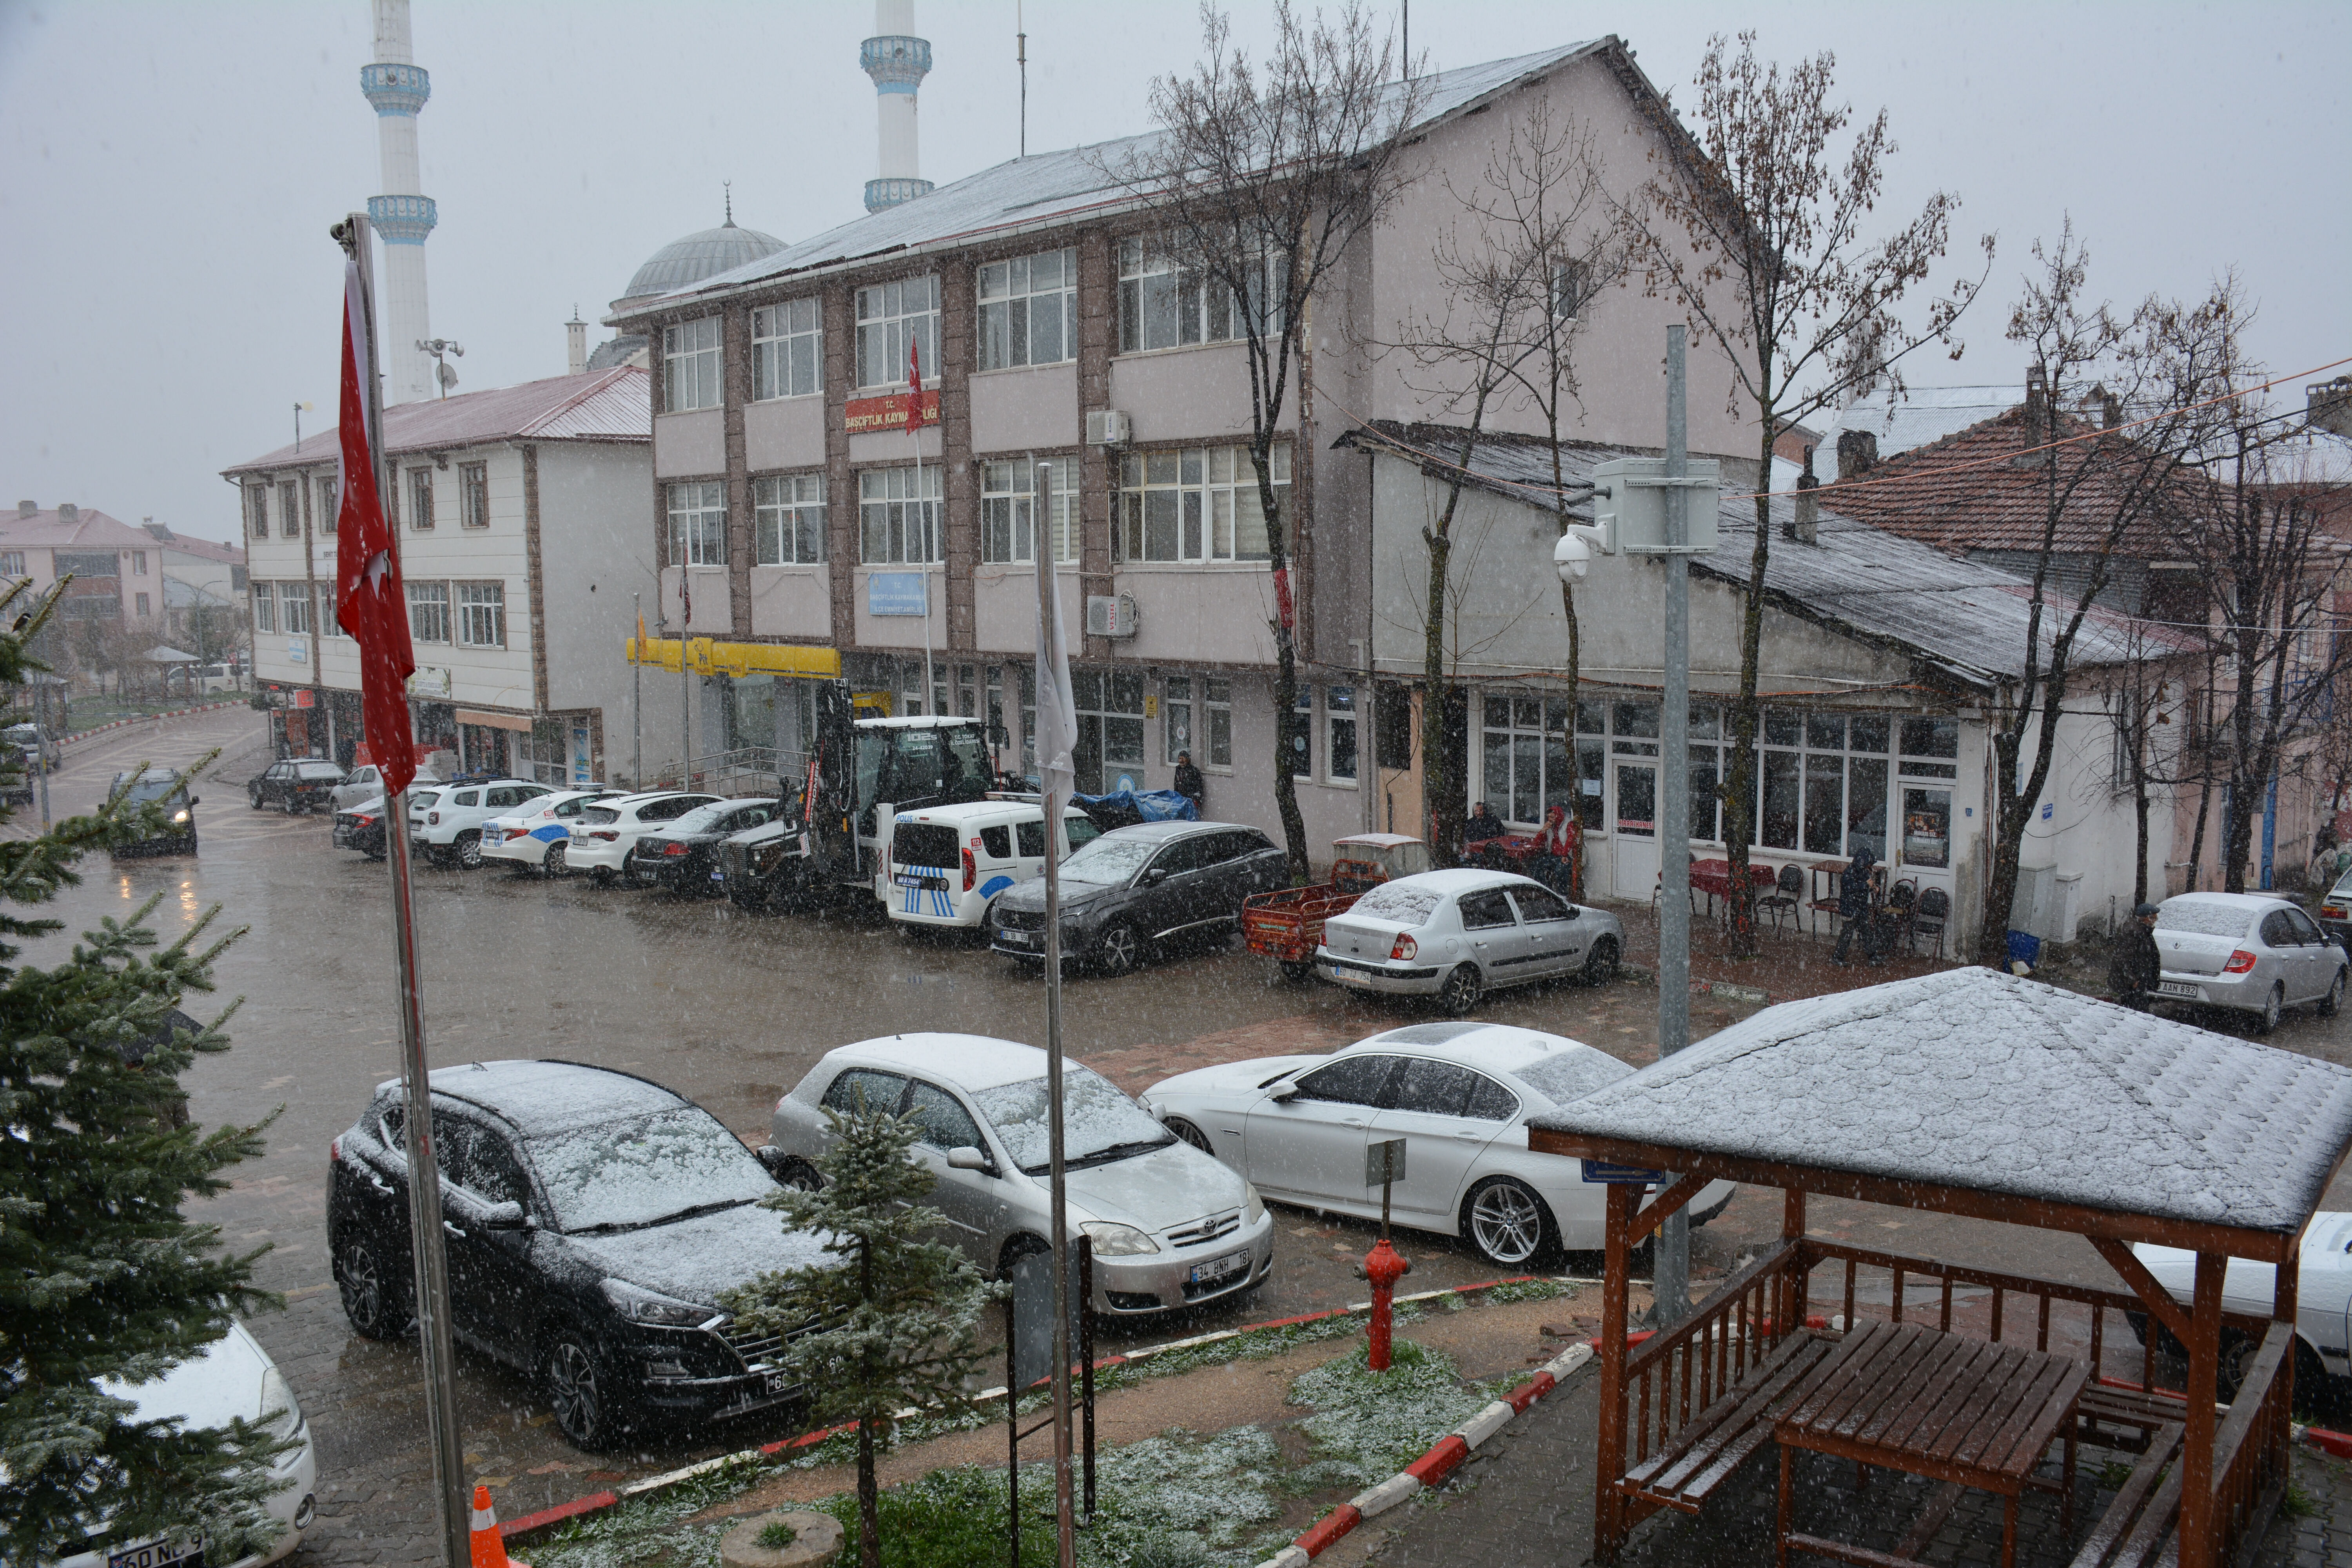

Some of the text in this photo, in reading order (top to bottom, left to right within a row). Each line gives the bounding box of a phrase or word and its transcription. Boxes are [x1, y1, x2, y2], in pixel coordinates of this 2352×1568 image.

[886, 400, 895, 408] T.C.
[846, 405, 937, 430] BAŞÇİFTLİK KAYMALIĞI
[699, 653, 708, 665] Ptt
[1618, 820, 1653, 829] KIRAATHANESİ
[1339, 968, 1346, 976] 60
[1350, 970, 1356, 978] TJ
[1360, 972, 1370, 981] 754
[2163, 983, 2178, 992] AAN
[2180, 985, 2196, 995] 892
[1198, 1252, 1247, 1279] 34 BNH 18
[124, 1550, 152, 1568] 60
